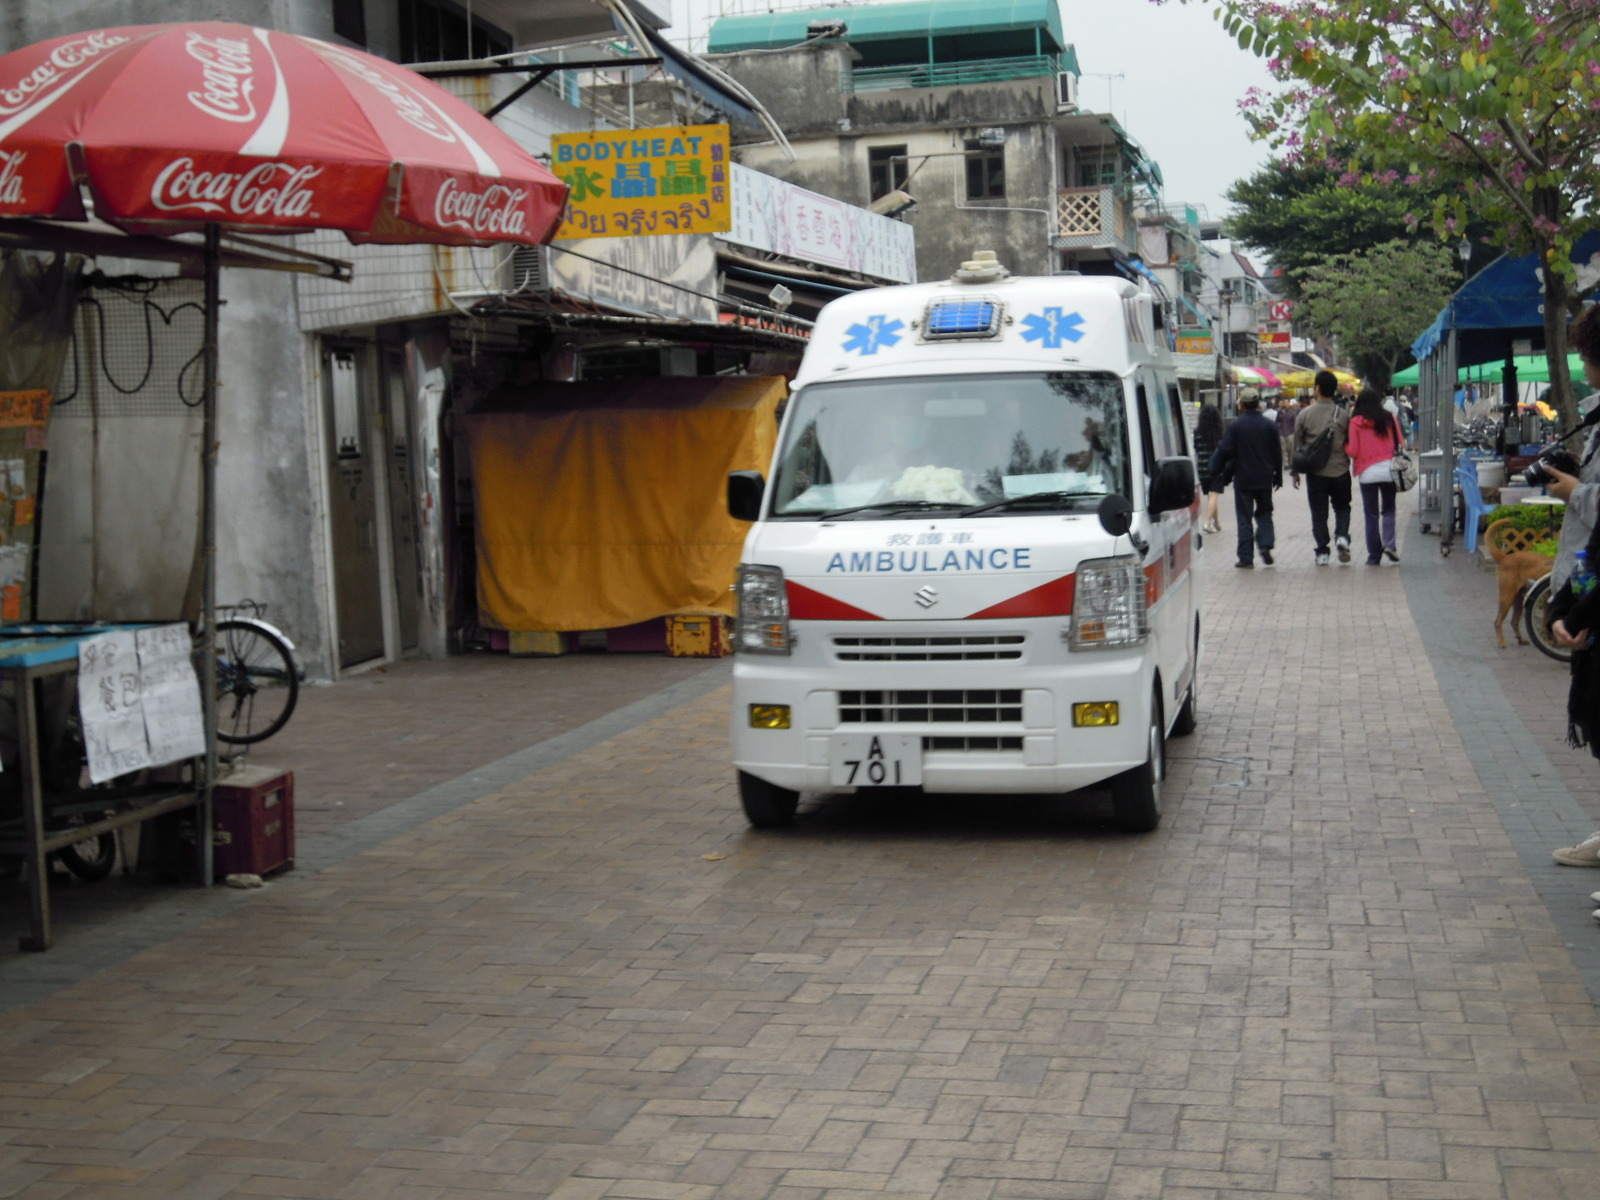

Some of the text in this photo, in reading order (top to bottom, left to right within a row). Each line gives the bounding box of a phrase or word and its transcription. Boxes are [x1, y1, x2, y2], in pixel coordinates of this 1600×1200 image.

[558, 136, 703, 163] BODYHEAT
[151, 157, 325, 217] Coca-Cola
[560, 158, 707, 202] 水晶晶
[435, 178, 528, 235] Coca-Cola
[885, 532, 975, 547] 救護車
[826, 548, 1031, 573] AMBULANCE
[867, 735, 884, 760] A
[843, 760, 901, 785] 701
